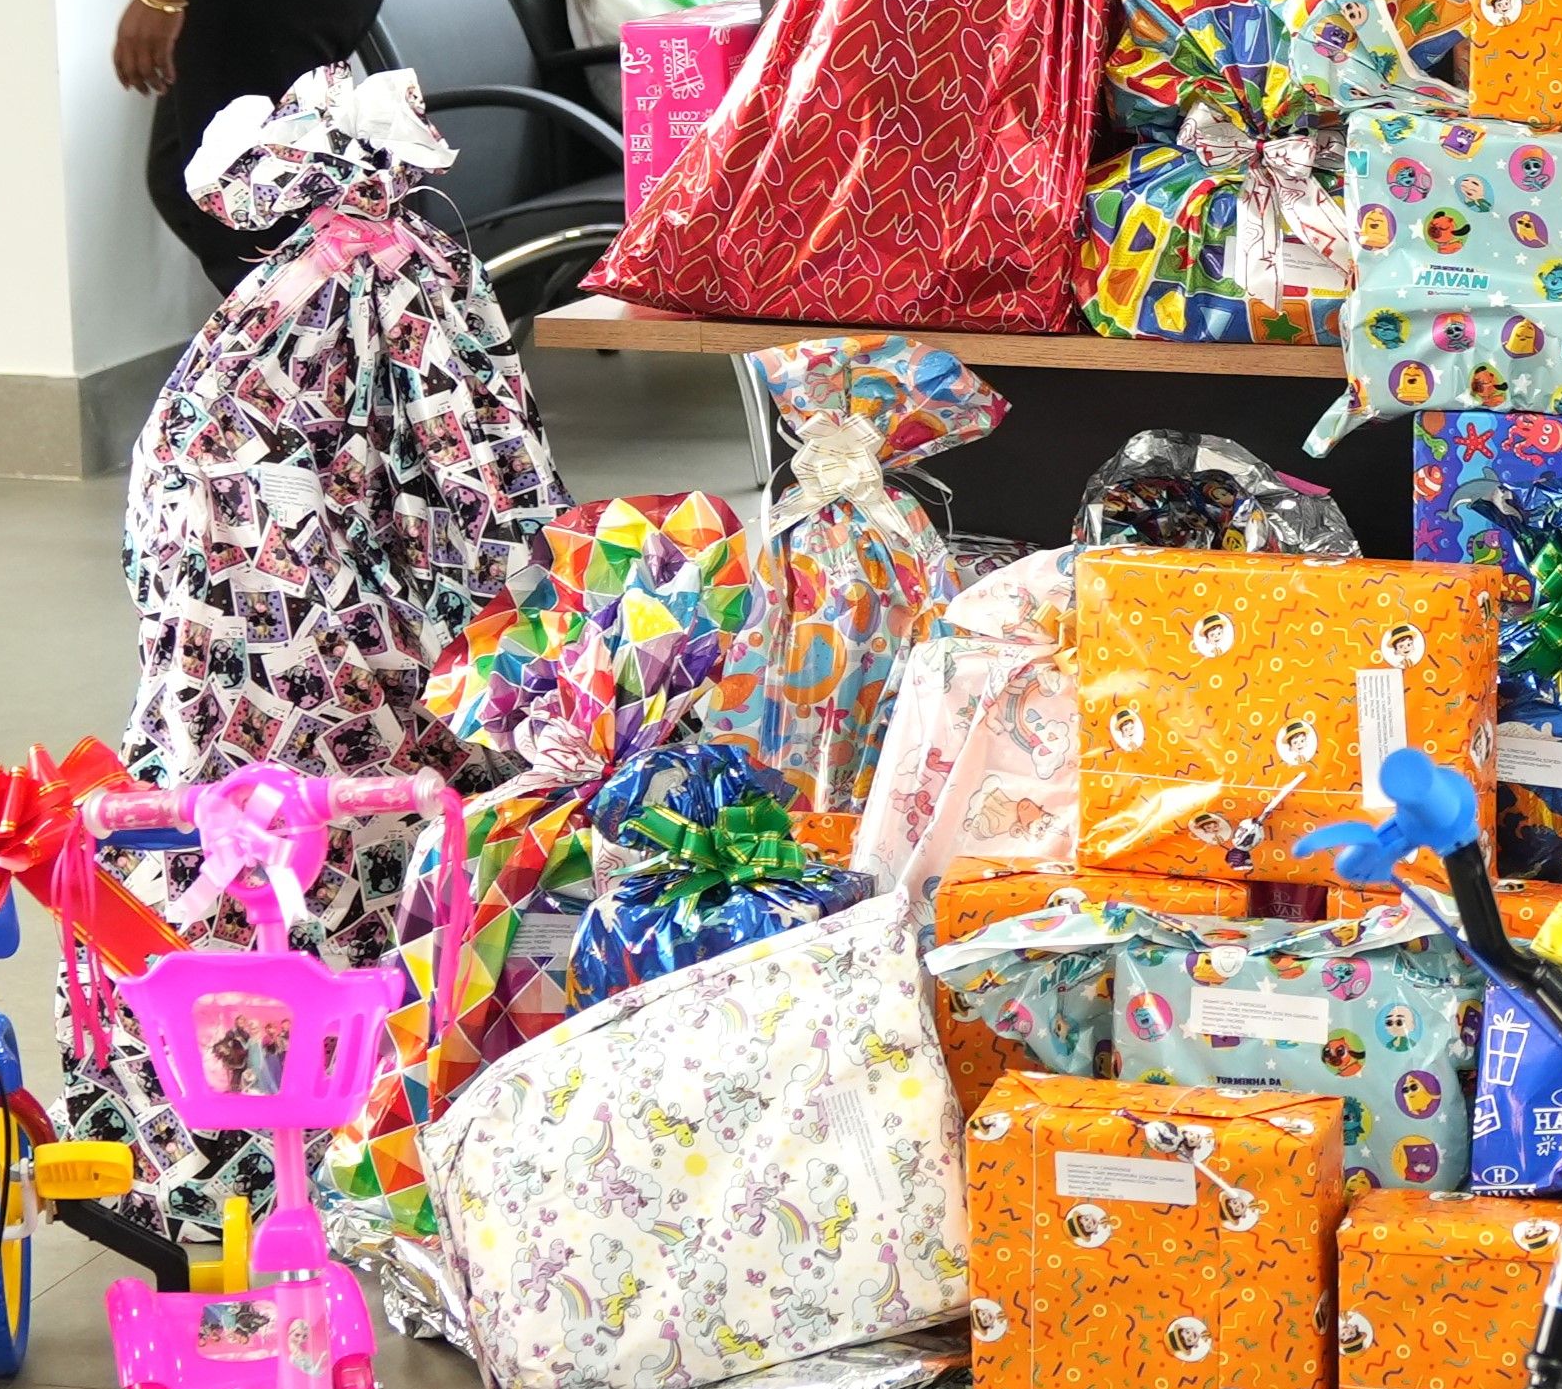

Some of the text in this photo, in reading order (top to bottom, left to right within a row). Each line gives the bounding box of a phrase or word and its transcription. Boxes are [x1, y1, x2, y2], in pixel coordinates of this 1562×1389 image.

[1415, 270, 1489, 290] HAVAN
[1216, 1075, 1282, 1087] TURMINHA DA
